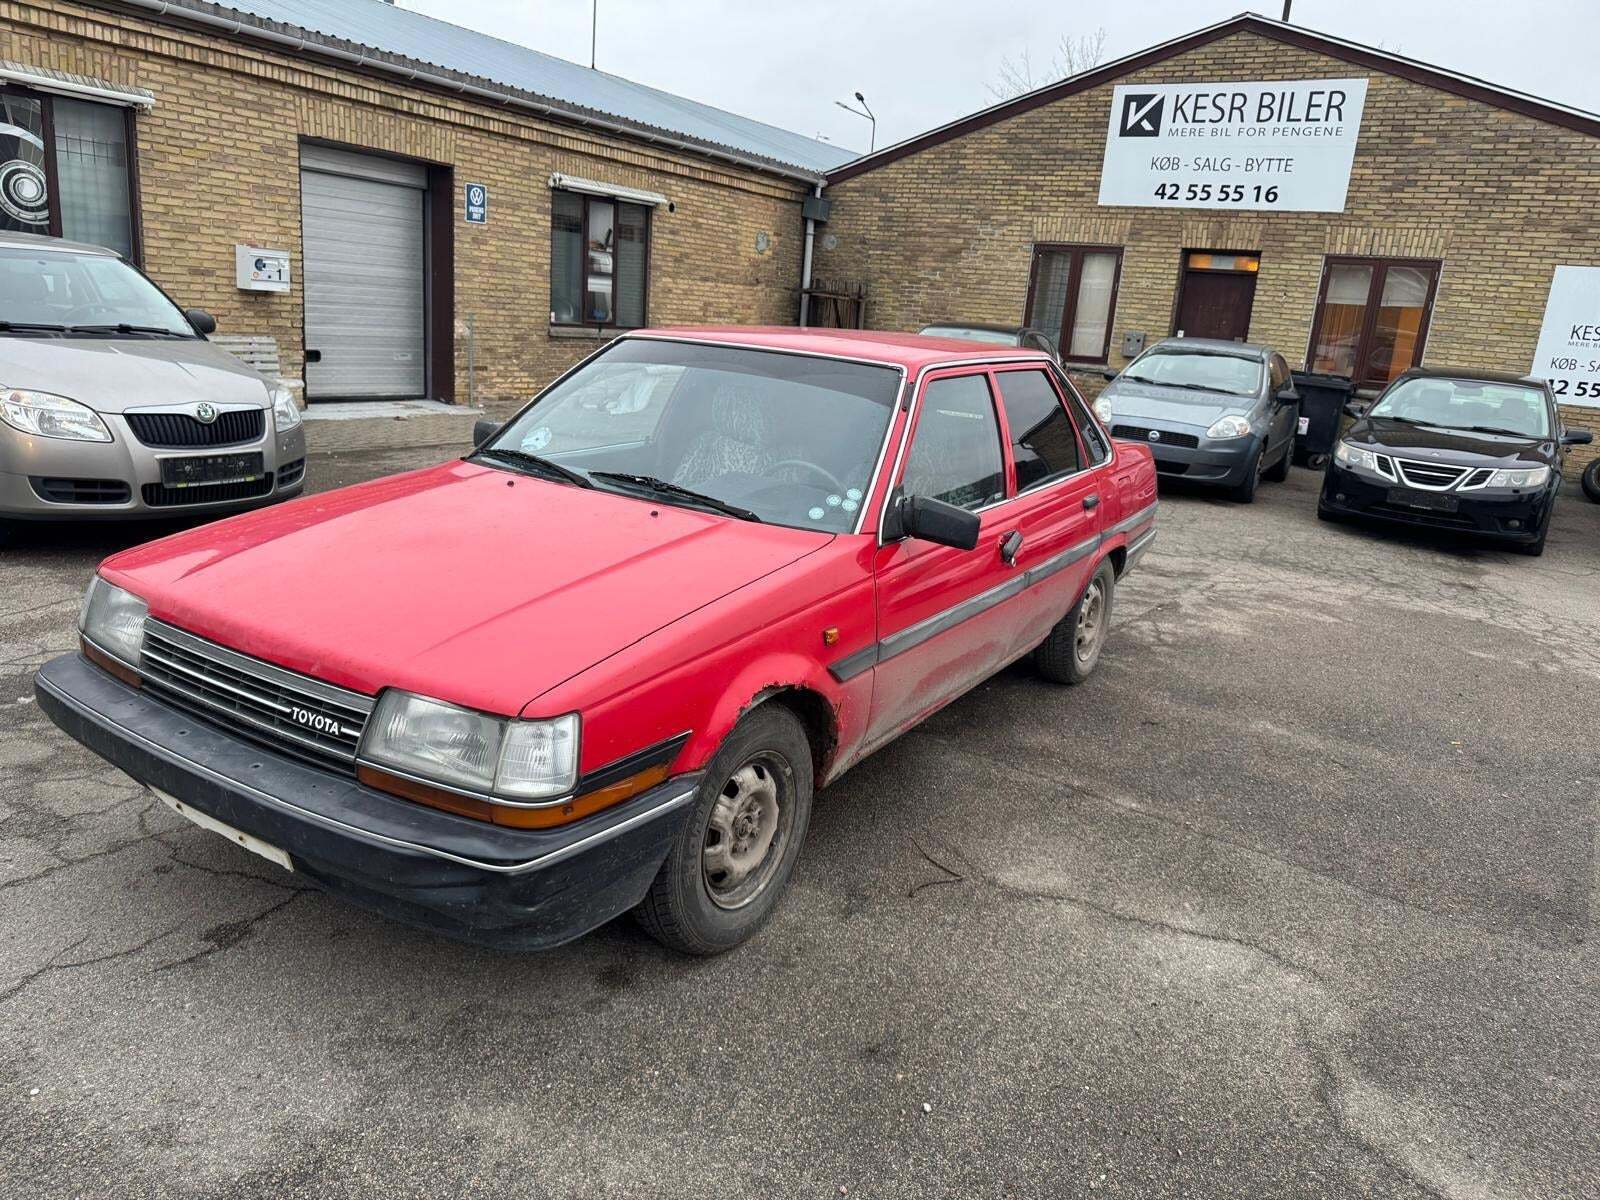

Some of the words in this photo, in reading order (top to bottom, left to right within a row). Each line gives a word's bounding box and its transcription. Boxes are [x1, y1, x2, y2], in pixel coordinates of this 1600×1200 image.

[1172, 92, 1248, 124] KESR
[1256, 90, 1347, 123] BILER
[1167, 127, 1205, 137] MERE
[1210, 127, 1232, 137] BIL
[1237, 127, 1267, 137] FOR
[1272, 126, 1344, 137] PENGENE
[1150, 156, 1181, 171] KØB
[1192, 157, 1232, 172] SALG
[1244, 157, 1294, 173] BYTTE
[1154, 183, 1180, 200] 42
[1185, 183, 1212, 201] 55
[1217, 184, 1245, 202] 55
[1253, 185, 1279, 203] 16
[1550, 357, 1578, 371] KØB
[292, 706, 339, 735] TOYOTA
